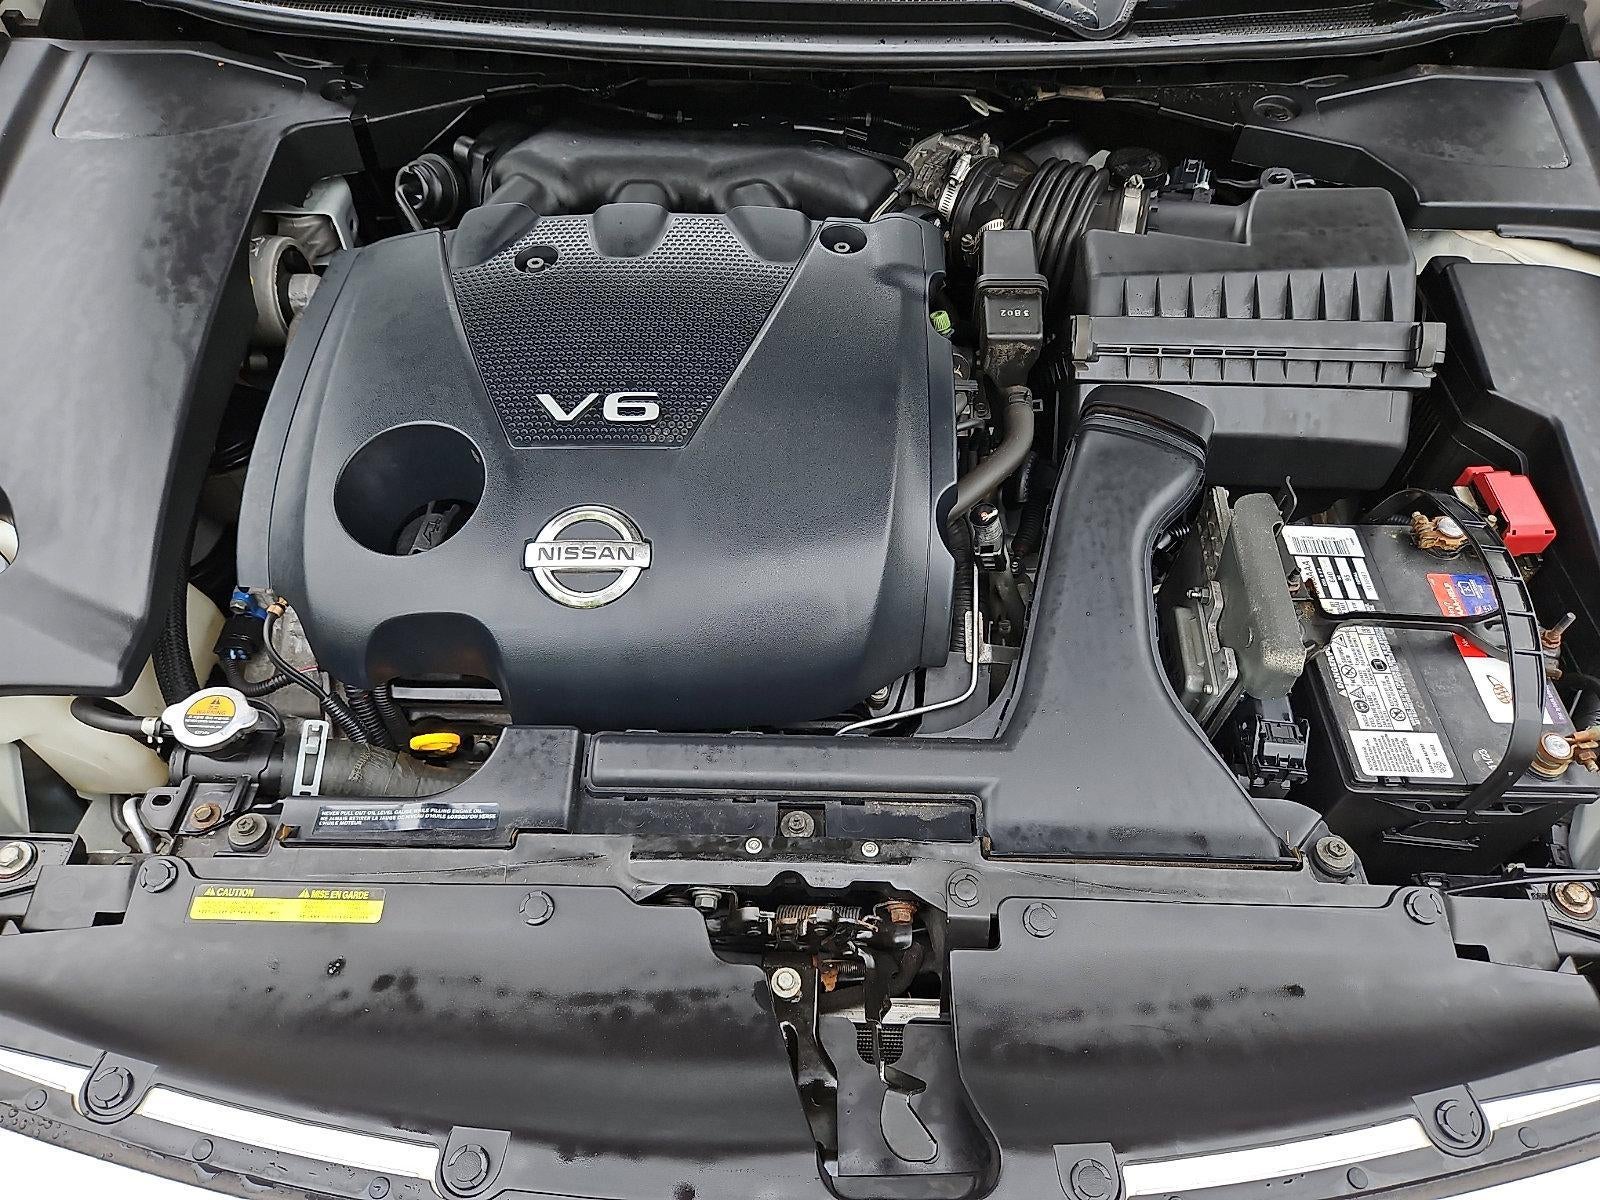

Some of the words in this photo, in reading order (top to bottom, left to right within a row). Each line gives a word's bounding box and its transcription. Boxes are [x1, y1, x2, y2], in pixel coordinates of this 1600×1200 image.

[536, 392, 660, 421] V6
[538, 546, 635, 561] NISSAN
[216, 888, 256, 897] CAUTION
[310, 889, 330, 899] MISE
[330, 890, 342, 899] EN
[342, 890, 370, 900] GARDE
